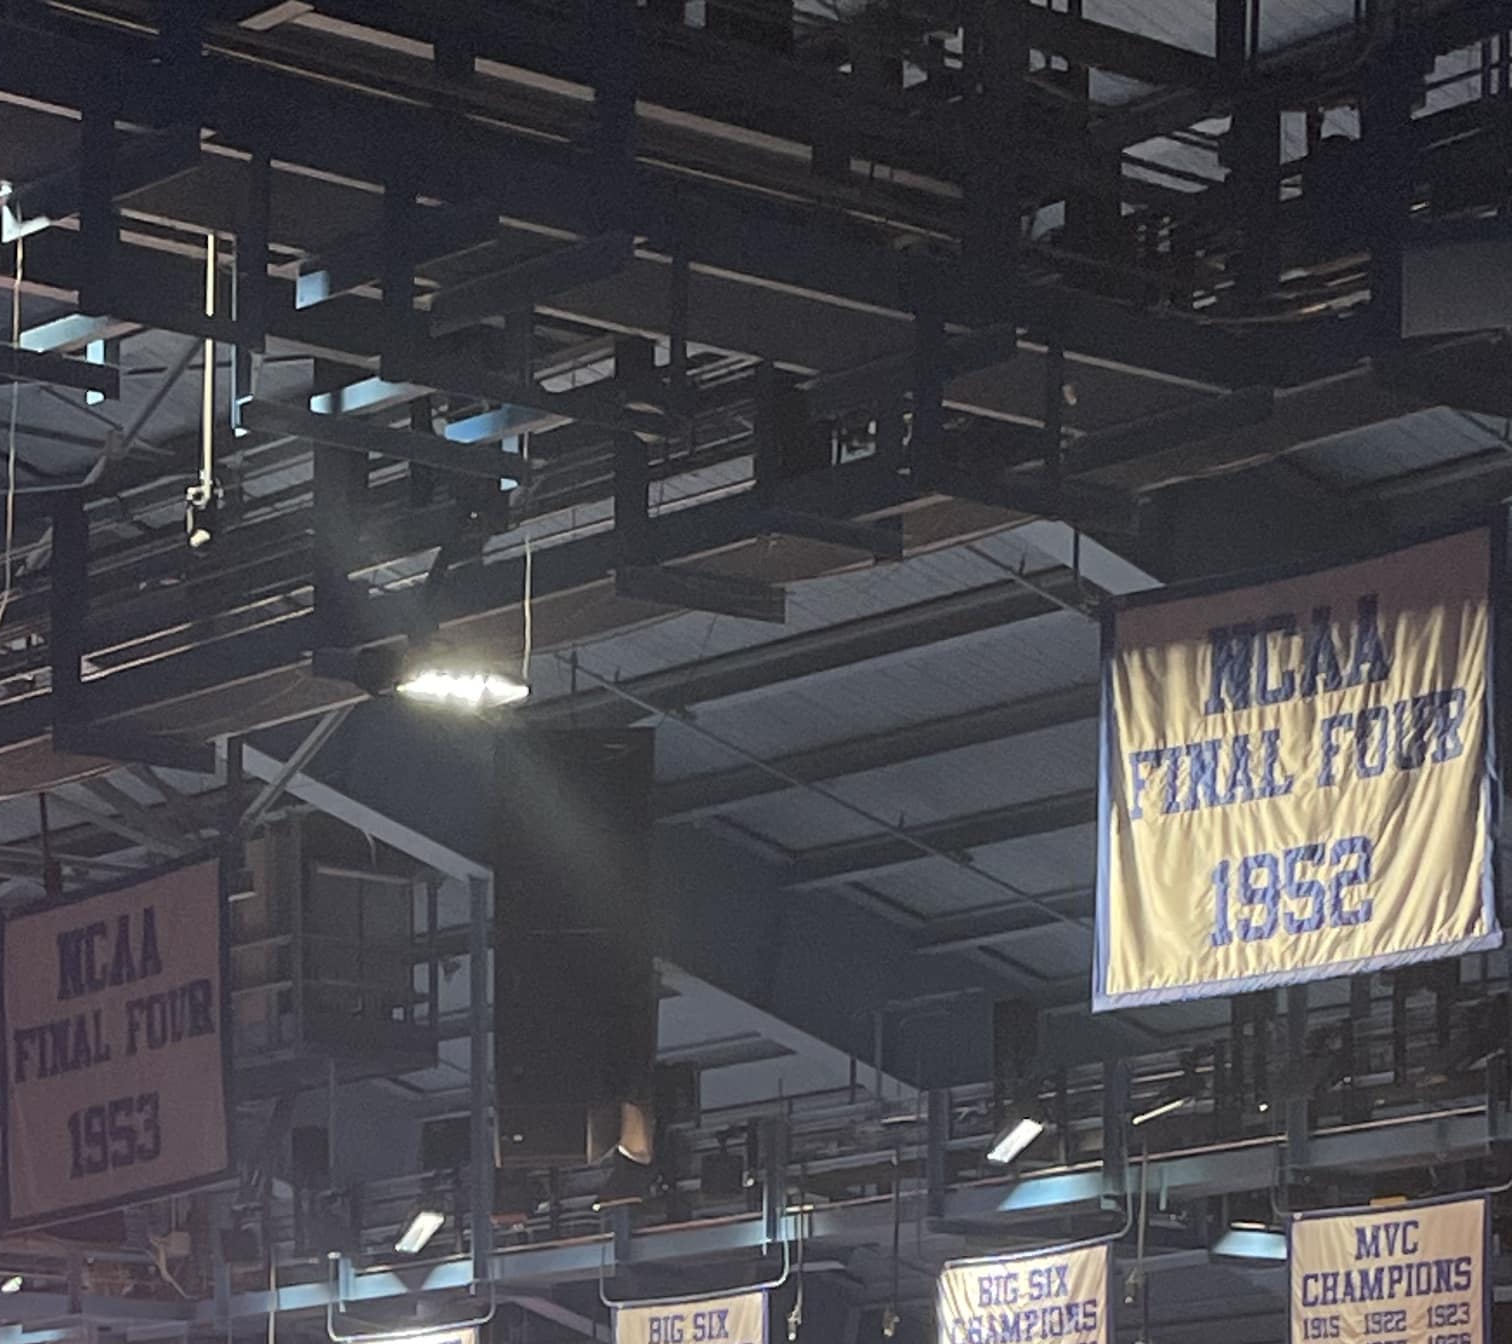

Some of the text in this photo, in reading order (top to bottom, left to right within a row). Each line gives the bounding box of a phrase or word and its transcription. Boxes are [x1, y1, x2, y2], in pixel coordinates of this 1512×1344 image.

[1205, 593, 1387, 716] NCAA
[1128, 687, 1467, 821] FINAL FOUR
[1210, 835, 1373, 947] 1952
[57, 904, 163, 1000] NCAA
[13, 978, 216, 1083] FINAL FOUR
[69, 1091, 161, 1180] 1953
[1301, 1256, 1472, 1307] CHAMPIONS
[1354, 1220, 1419, 1260] MVC
[693, 1309, 729, 1342] SIX
[978, 1264, 1069, 1308] BIG SIX
[1363, 1310, 1407, 1335] 1922
[1427, 1302, 1471, 1328] 1923
